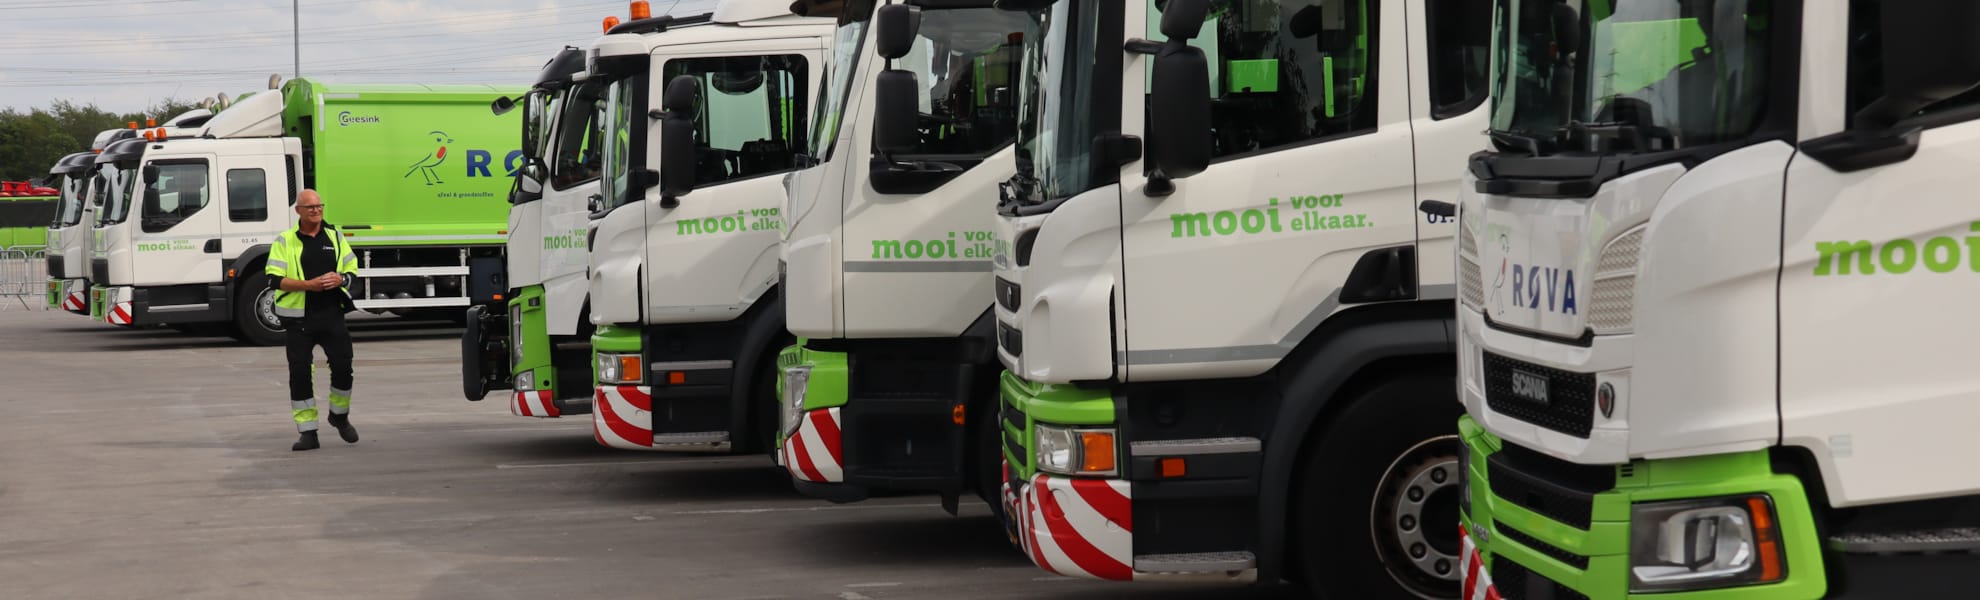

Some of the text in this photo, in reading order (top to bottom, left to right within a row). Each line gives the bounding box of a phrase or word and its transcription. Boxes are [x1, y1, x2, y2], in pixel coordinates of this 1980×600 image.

[340, 112, 380, 124] Geesink
[1290, 193, 1343, 210] voor
[677, 209, 746, 235] mooi
[752, 207, 781, 217] voo
[1170, 197, 1282, 238] mooi
[1291, 212, 1374, 231] elkaar.
[137, 240, 171, 252] mooi
[544, 229, 572, 250] mooi
[872, 231, 958, 259] mooi
[1813, 220, 1980, 276] mooi
[964, 243, 993, 258] elk
[1512, 372, 1548, 402] SCANIA
